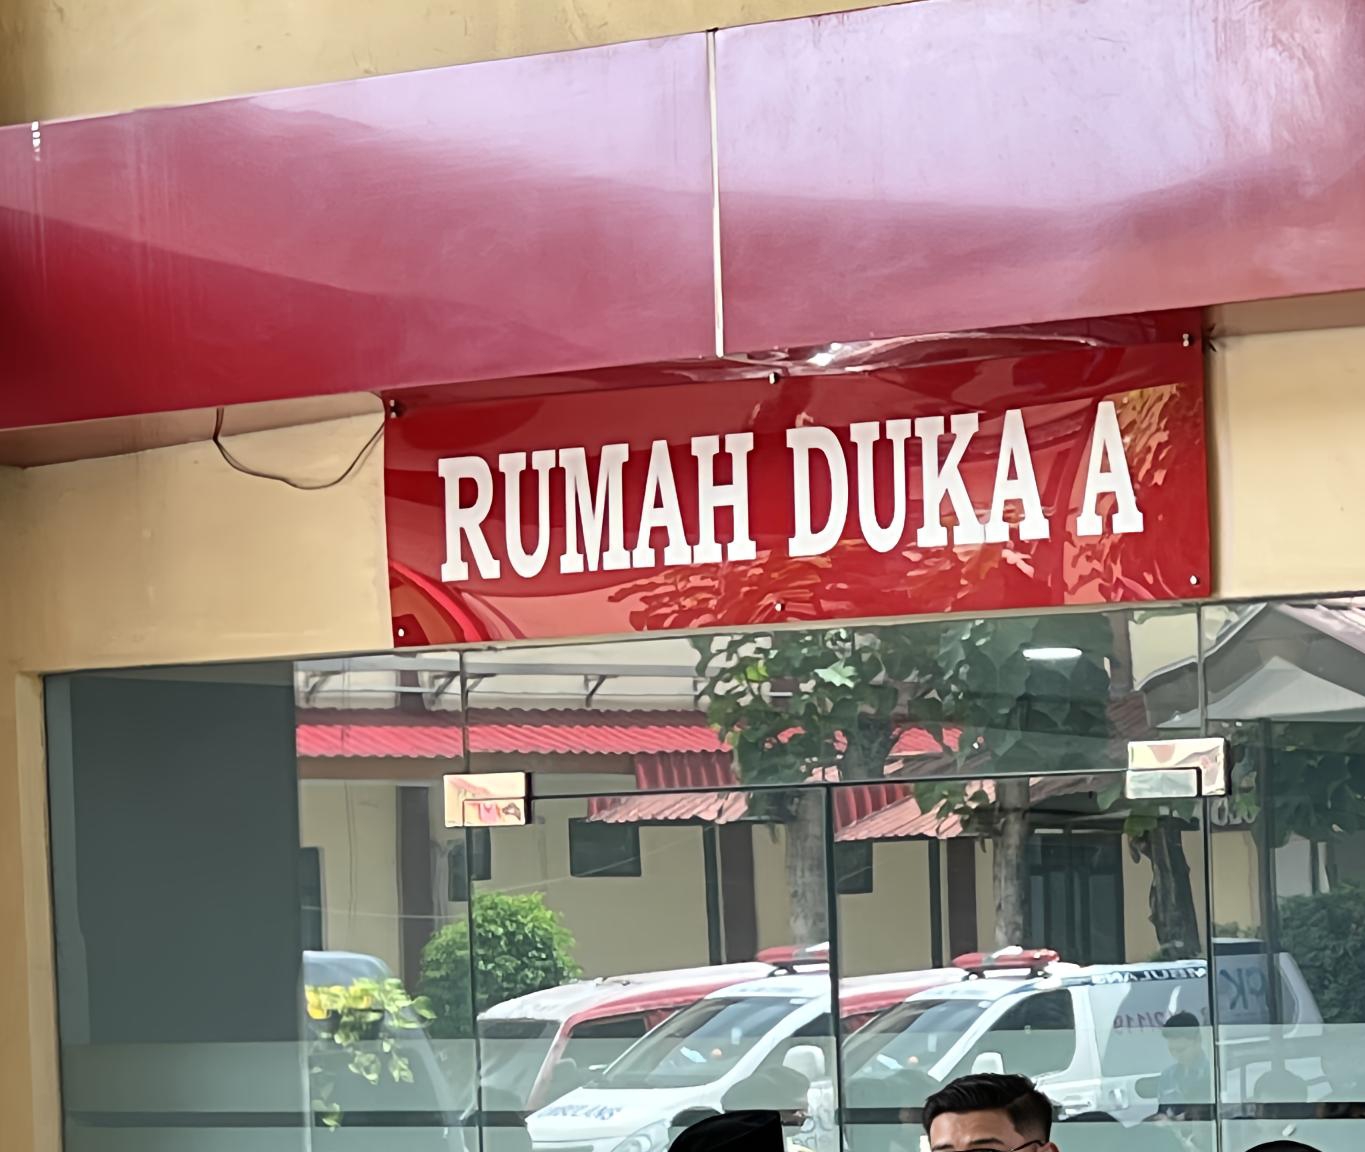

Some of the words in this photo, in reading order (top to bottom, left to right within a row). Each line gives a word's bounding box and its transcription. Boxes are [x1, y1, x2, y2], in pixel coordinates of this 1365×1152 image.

[438, 432, 757, 583] RUMAH
[787, 408, 1050, 557] DUKA
[1077, 401, 1144, 537] A
